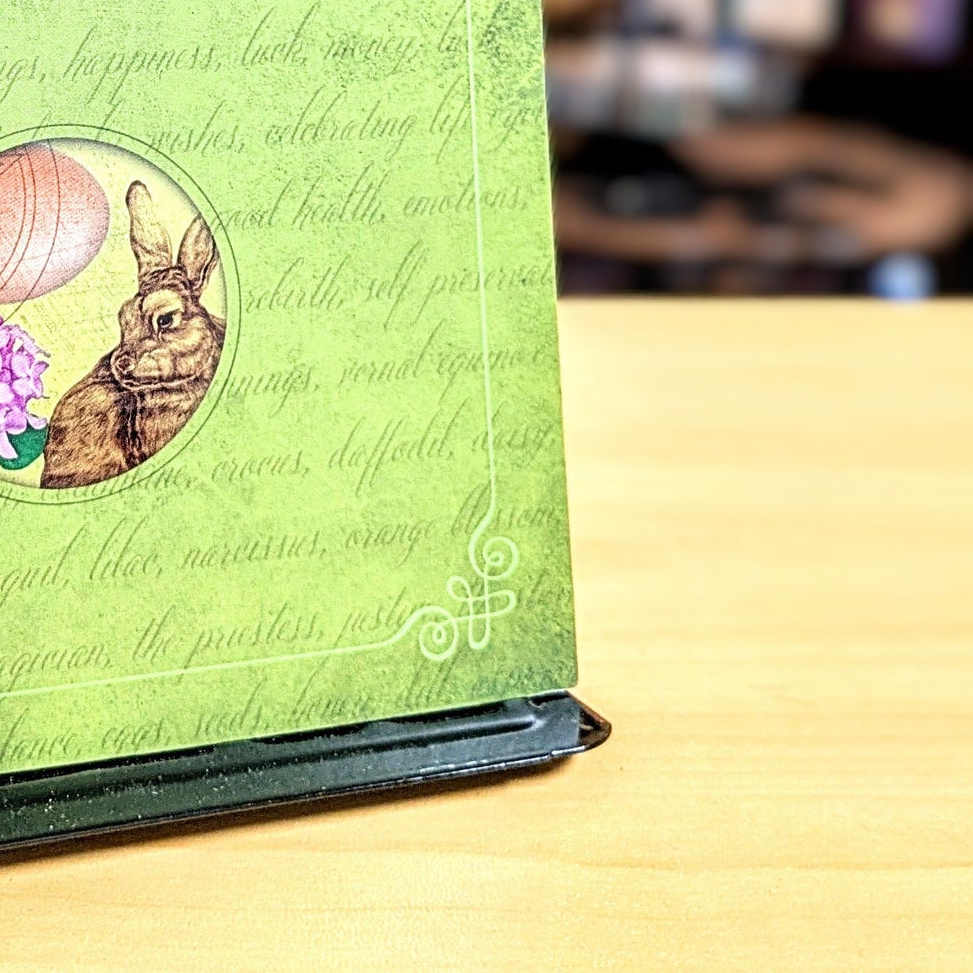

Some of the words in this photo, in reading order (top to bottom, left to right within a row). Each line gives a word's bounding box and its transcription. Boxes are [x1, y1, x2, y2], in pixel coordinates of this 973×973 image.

[63, 26, 223, 107] happiness,
[293, 157, 387, 233] health,
[327, 399, 457, 497] daffodil,
